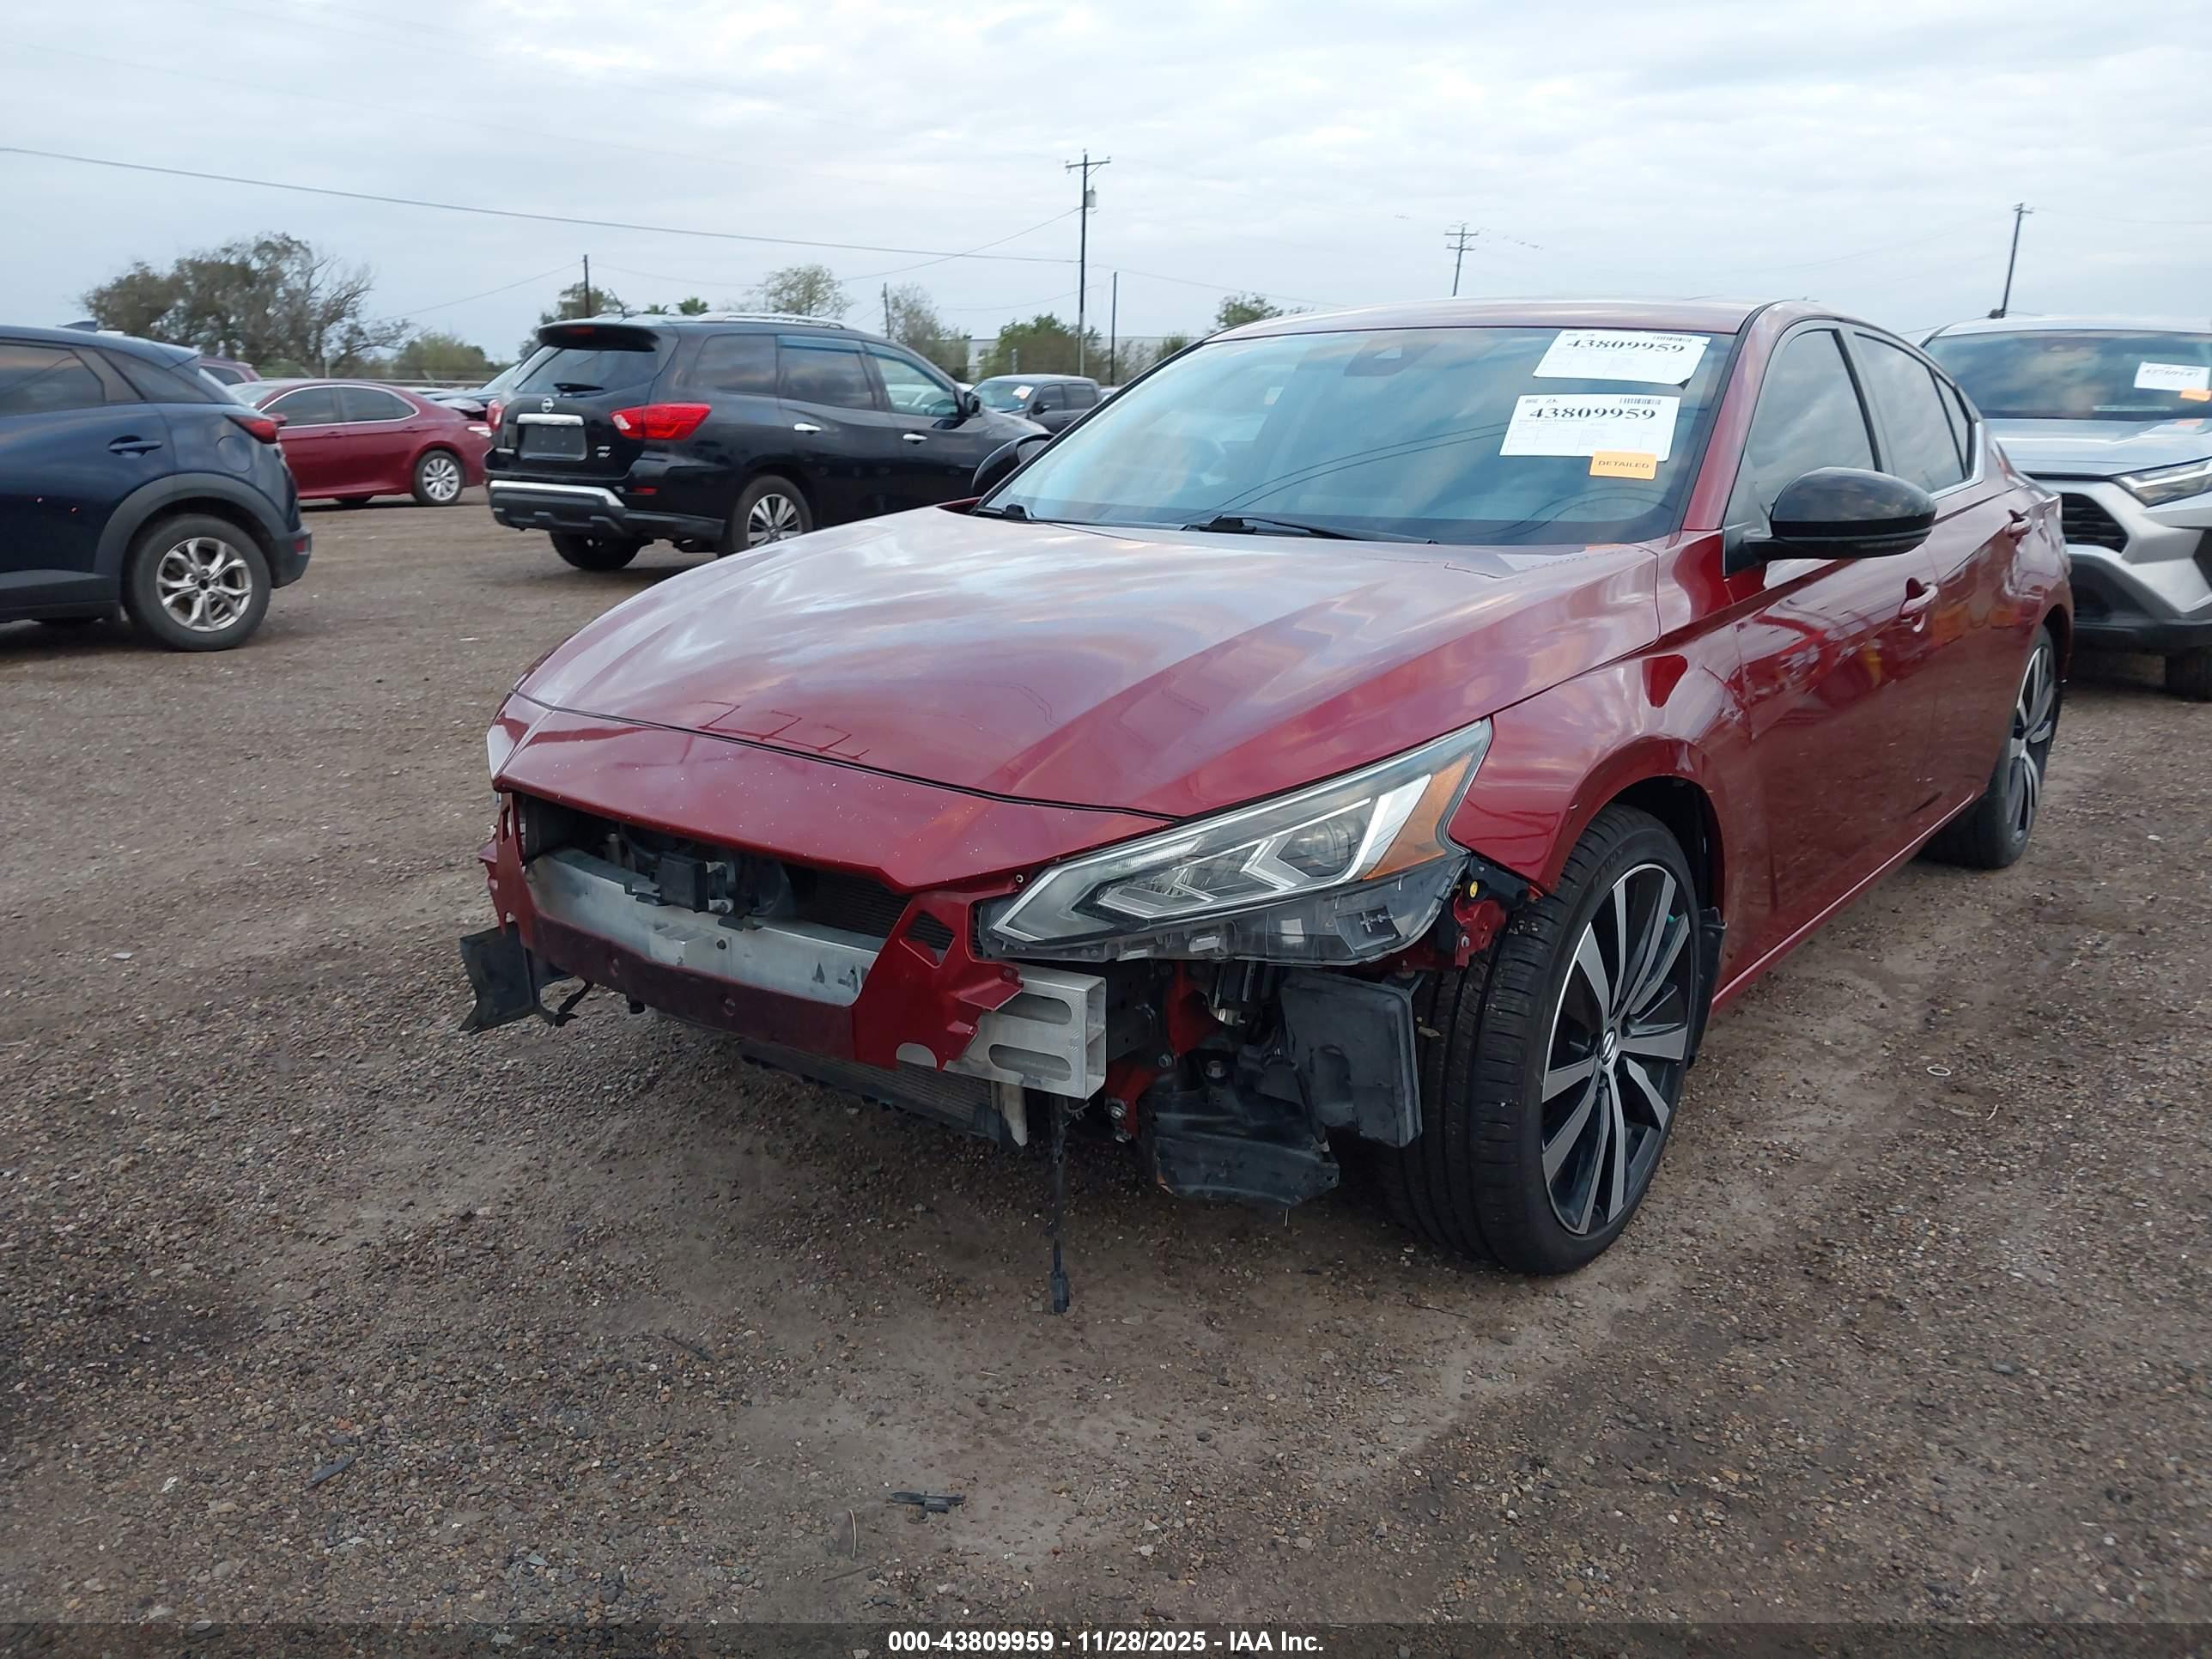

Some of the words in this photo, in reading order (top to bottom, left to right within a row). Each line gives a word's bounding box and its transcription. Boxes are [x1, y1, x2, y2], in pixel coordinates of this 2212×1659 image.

[1566, 338, 1685, 353] 43809959
[1528, 407, 1656, 420] 43809959
[1597, 459, 1650, 469] DETAILED
